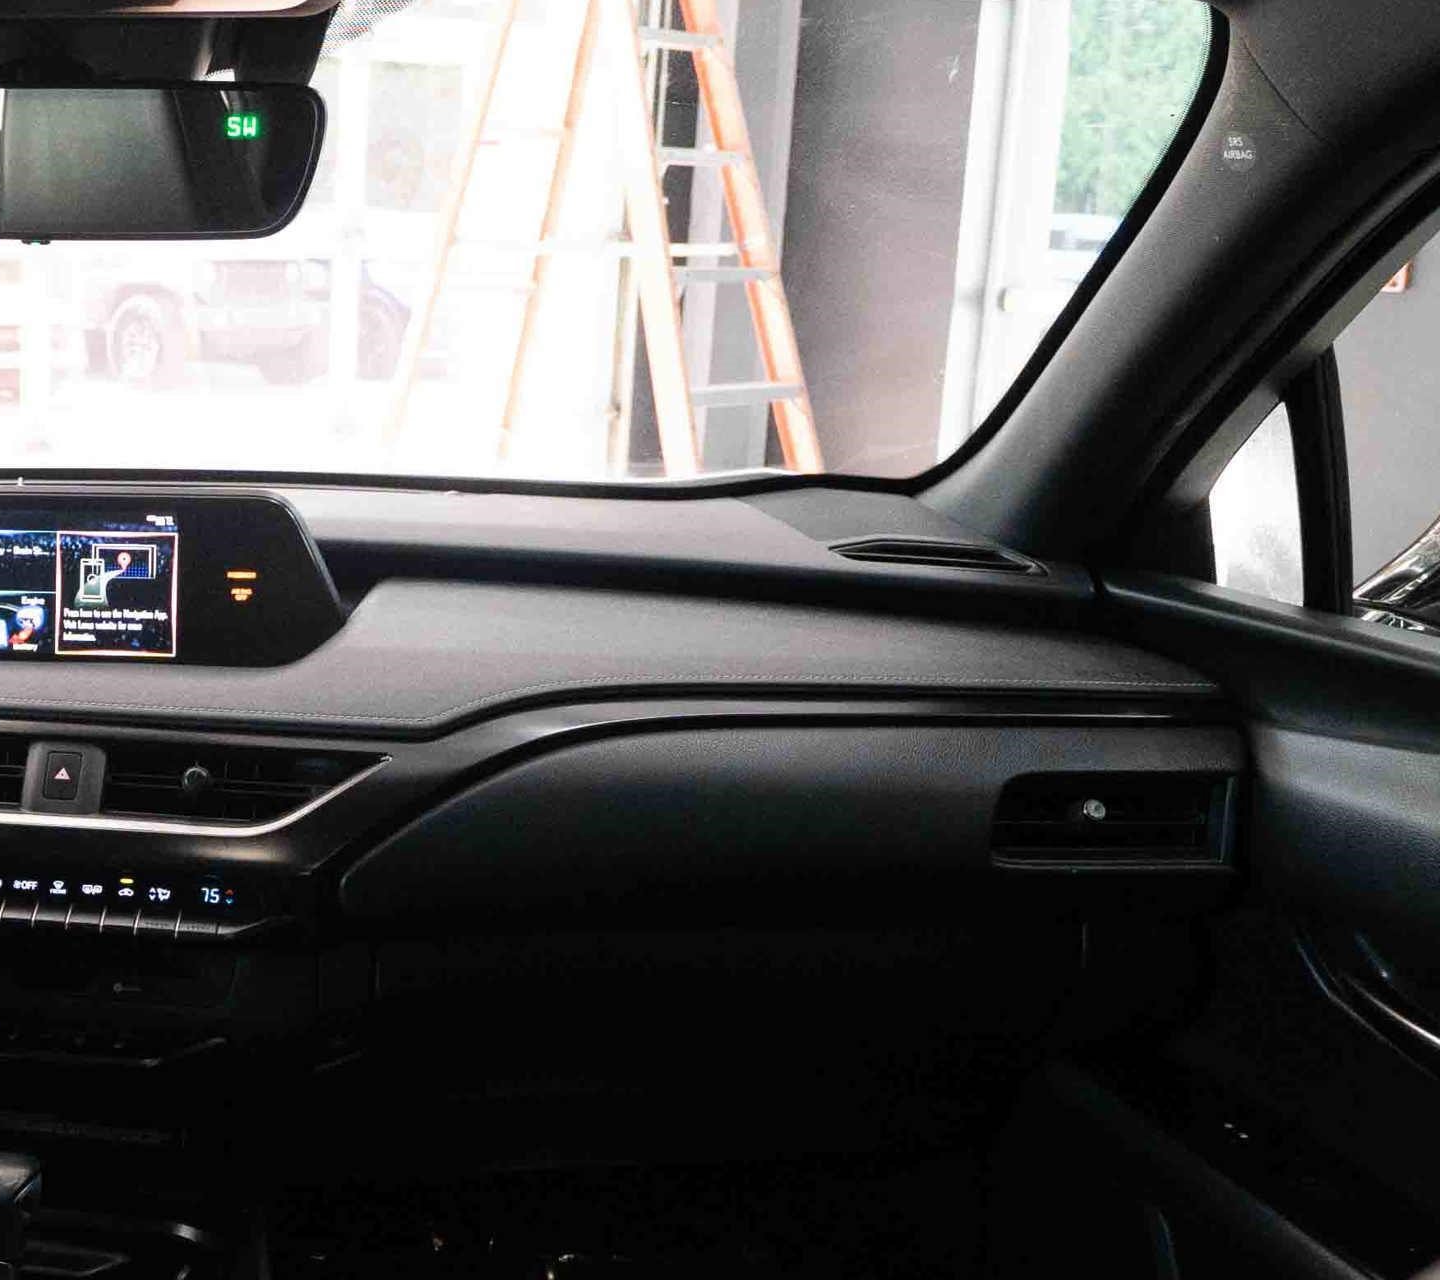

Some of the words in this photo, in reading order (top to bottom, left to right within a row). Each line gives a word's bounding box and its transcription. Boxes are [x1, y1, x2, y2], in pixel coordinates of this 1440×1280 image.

[227, 116, 257, 137] SW
[1228, 136, 1243, 147] SRS
[21, 880, 38, 890] OFF
[201, 887, 220, 904] 75
